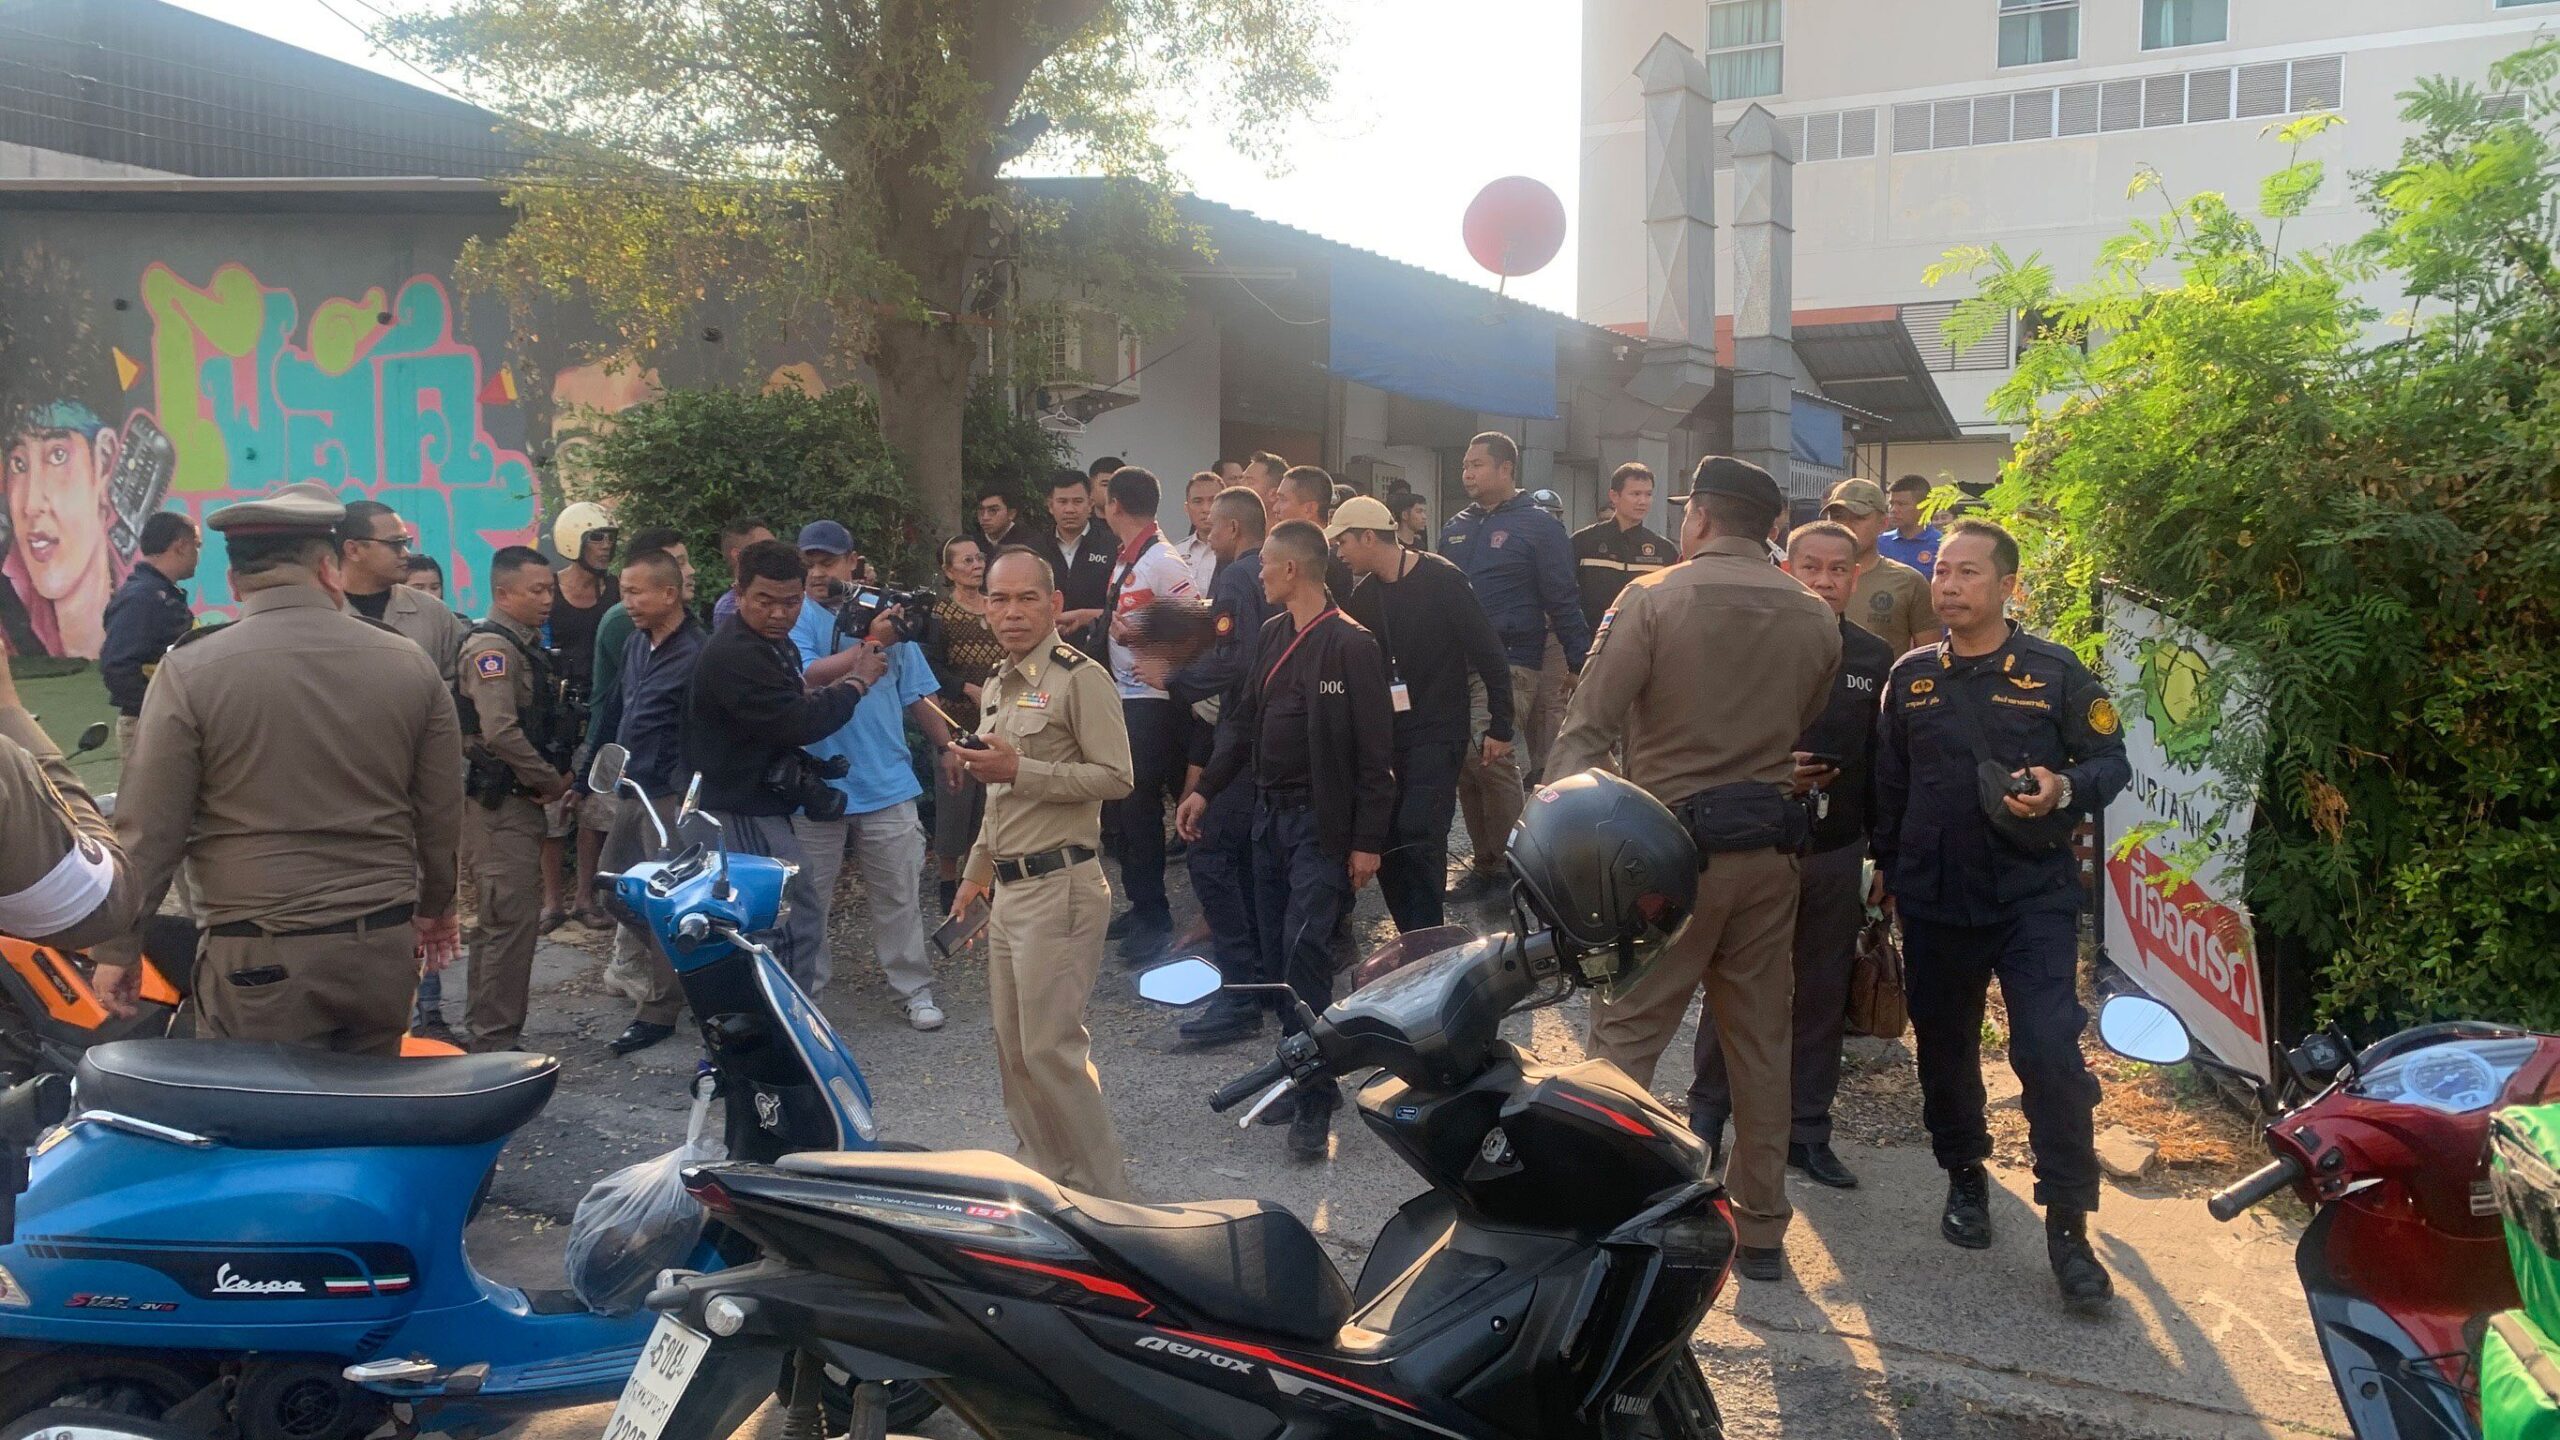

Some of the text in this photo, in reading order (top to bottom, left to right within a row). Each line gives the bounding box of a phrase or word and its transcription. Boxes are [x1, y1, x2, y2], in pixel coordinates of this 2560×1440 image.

[1088, 552, 1108, 564] DOC
[1319, 680, 1345, 694] DOC
[1846, 673, 1873, 692] DOC
[2129, 846, 2255, 1017] ที่จอดรถ
[936, 1204, 962, 1213] VVA
[967, 1206, 1009, 1219] 155
[211, 1262, 306, 1294] Vespa
